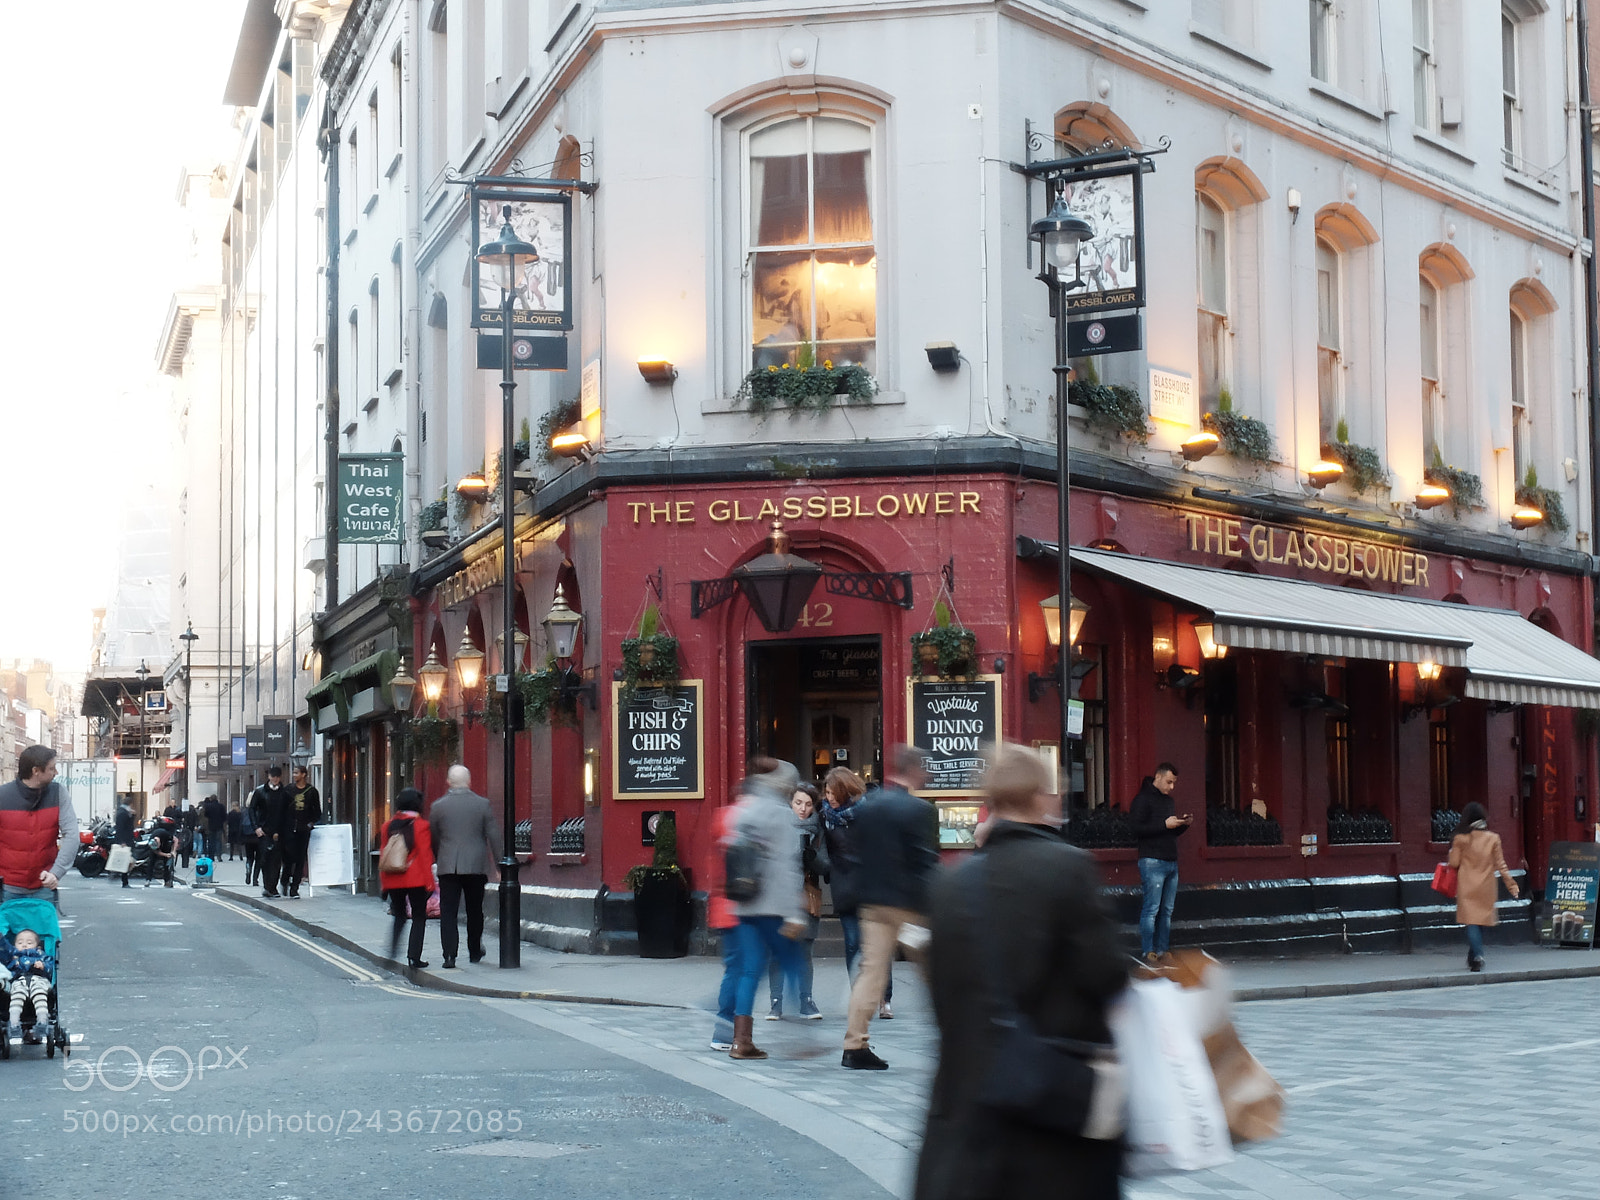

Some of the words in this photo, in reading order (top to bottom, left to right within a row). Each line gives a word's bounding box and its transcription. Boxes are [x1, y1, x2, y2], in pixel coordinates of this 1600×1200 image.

[1066, 293, 1135, 309] LASSBLOWER
[480, 313, 562, 325] GLASBLOWER
[1153, 374, 1191, 395] GLASSHOUSE
[1154, 389, 1175, 405] STREET
[347, 463, 389, 477] Thai
[344, 483, 393, 497] West
[346, 503, 390, 516] Cafe
[627, 501, 695, 523] THE
[708, 491, 981, 522] GLASSBLOWER
[1185, 513, 1242, 558] THE
[1249, 524, 1430, 588] GLASSBLOWER
[797, 602, 833, 627] 42
[927, 695, 979, 717] Upstairs
[628, 711, 667, 729] FISH
[672, 710, 688, 730] &
[926, 719, 984, 734] DINING
[632, 732, 681, 751] CHIPS
[931, 736, 979, 756] ROOM
[1543, 705, 1558, 794] INING
[1556, 881, 1587, 890] SHOWN
[1555, 889, 1586, 900] HERE
